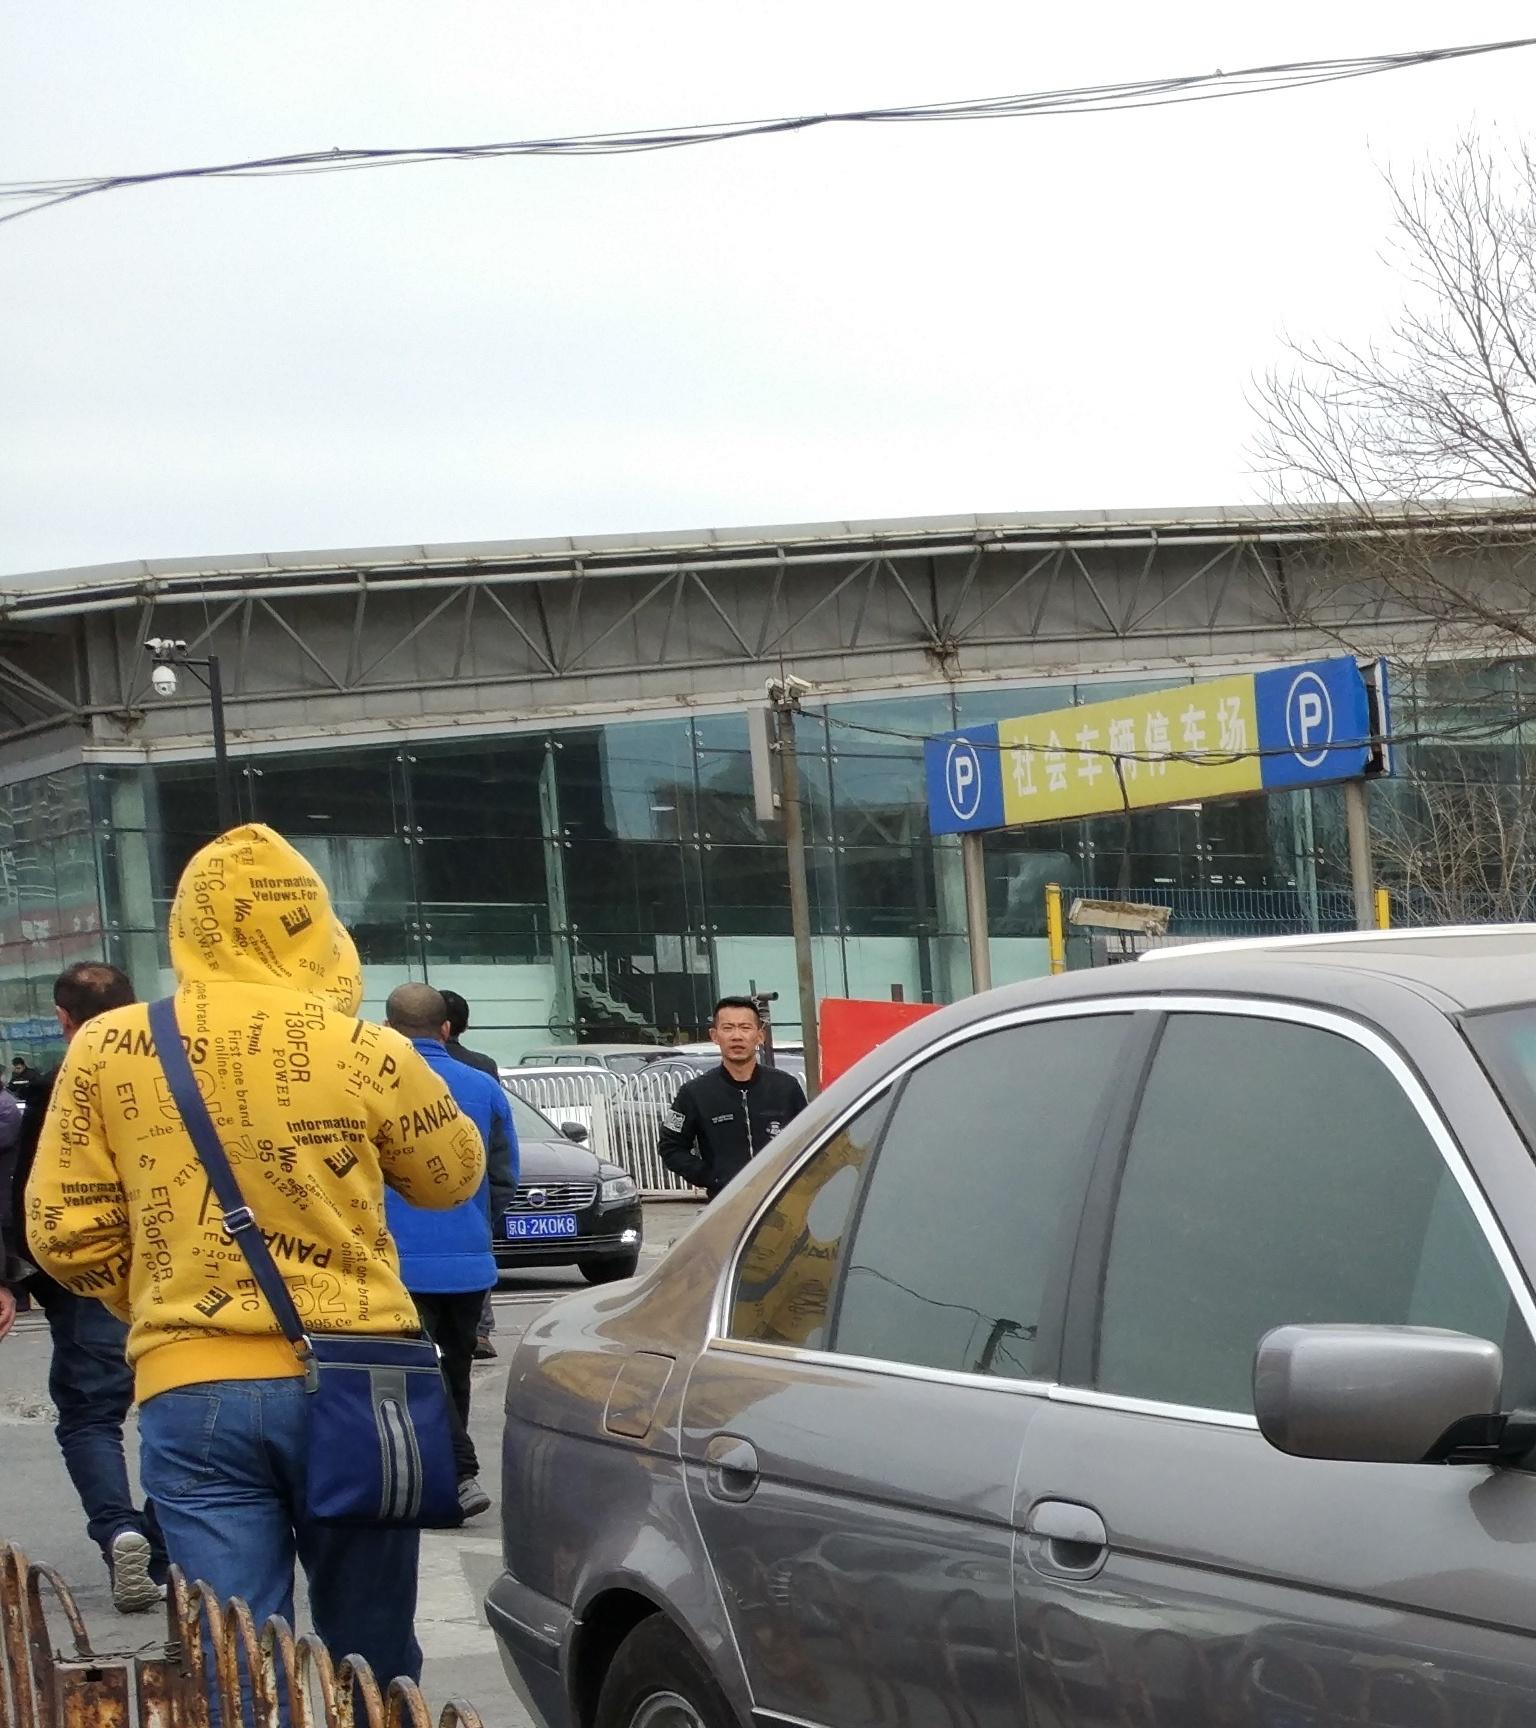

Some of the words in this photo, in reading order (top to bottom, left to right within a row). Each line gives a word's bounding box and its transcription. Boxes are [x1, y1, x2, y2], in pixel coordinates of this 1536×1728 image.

[1299, 694, 1321, 747] P
[1012, 696, 1247, 797] 社会车辆停车场
[955, 757, 973, 804] P
[304, 1002, 326, 1031] ETC
[100, 1028, 209, 1065] PANS
[285, 1011, 311, 1083] 130FOR
[273, 1048, 291, 1108] POWER
[116, 1082, 139, 1121] ETC
[426, 1155, 450, 1184] ETC
[151, 1185, 175, 1224] ETC
[141, 1203, 173, 1281] 130FOR
[237, 1278, 260, 1312] ETC
